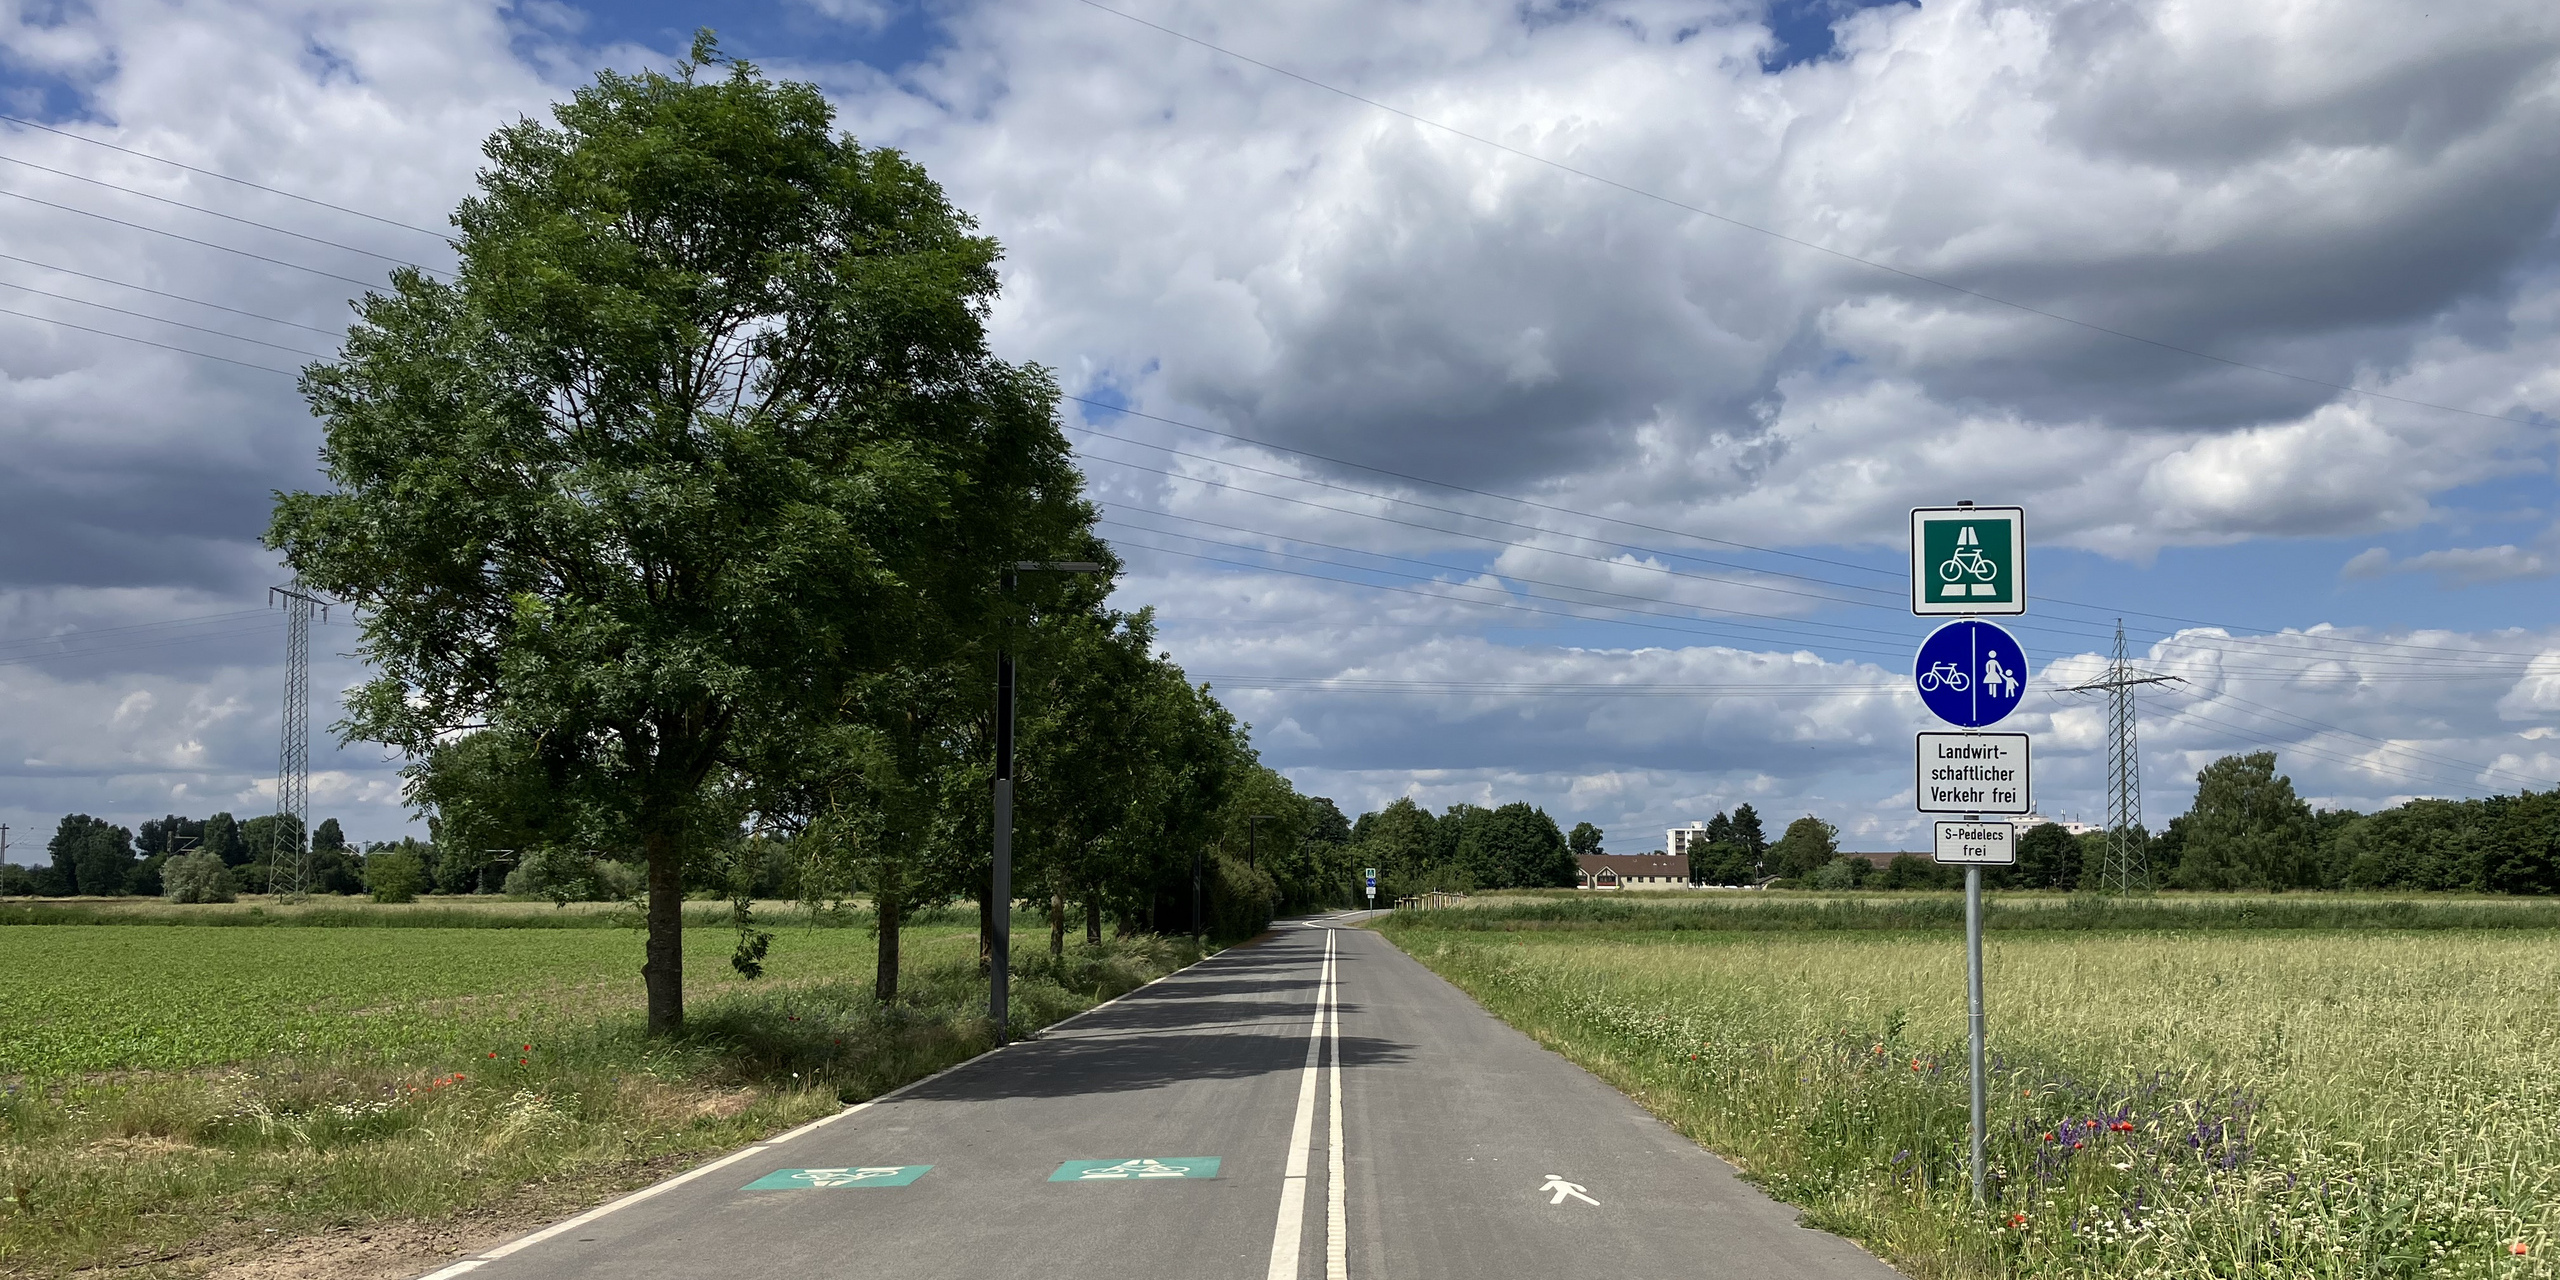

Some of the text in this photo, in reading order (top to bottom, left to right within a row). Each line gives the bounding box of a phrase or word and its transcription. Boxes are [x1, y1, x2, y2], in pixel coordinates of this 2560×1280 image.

[1938, 743, 2008, 760] Landwirt-
[1931, 765, 2015, 782] schaftlicher
[1930, 786, 2016, 804] Verkehr frei
[1945, 828, 2004, 841] S-Pedelecs
[1963, 844, 1987, 857] frei
